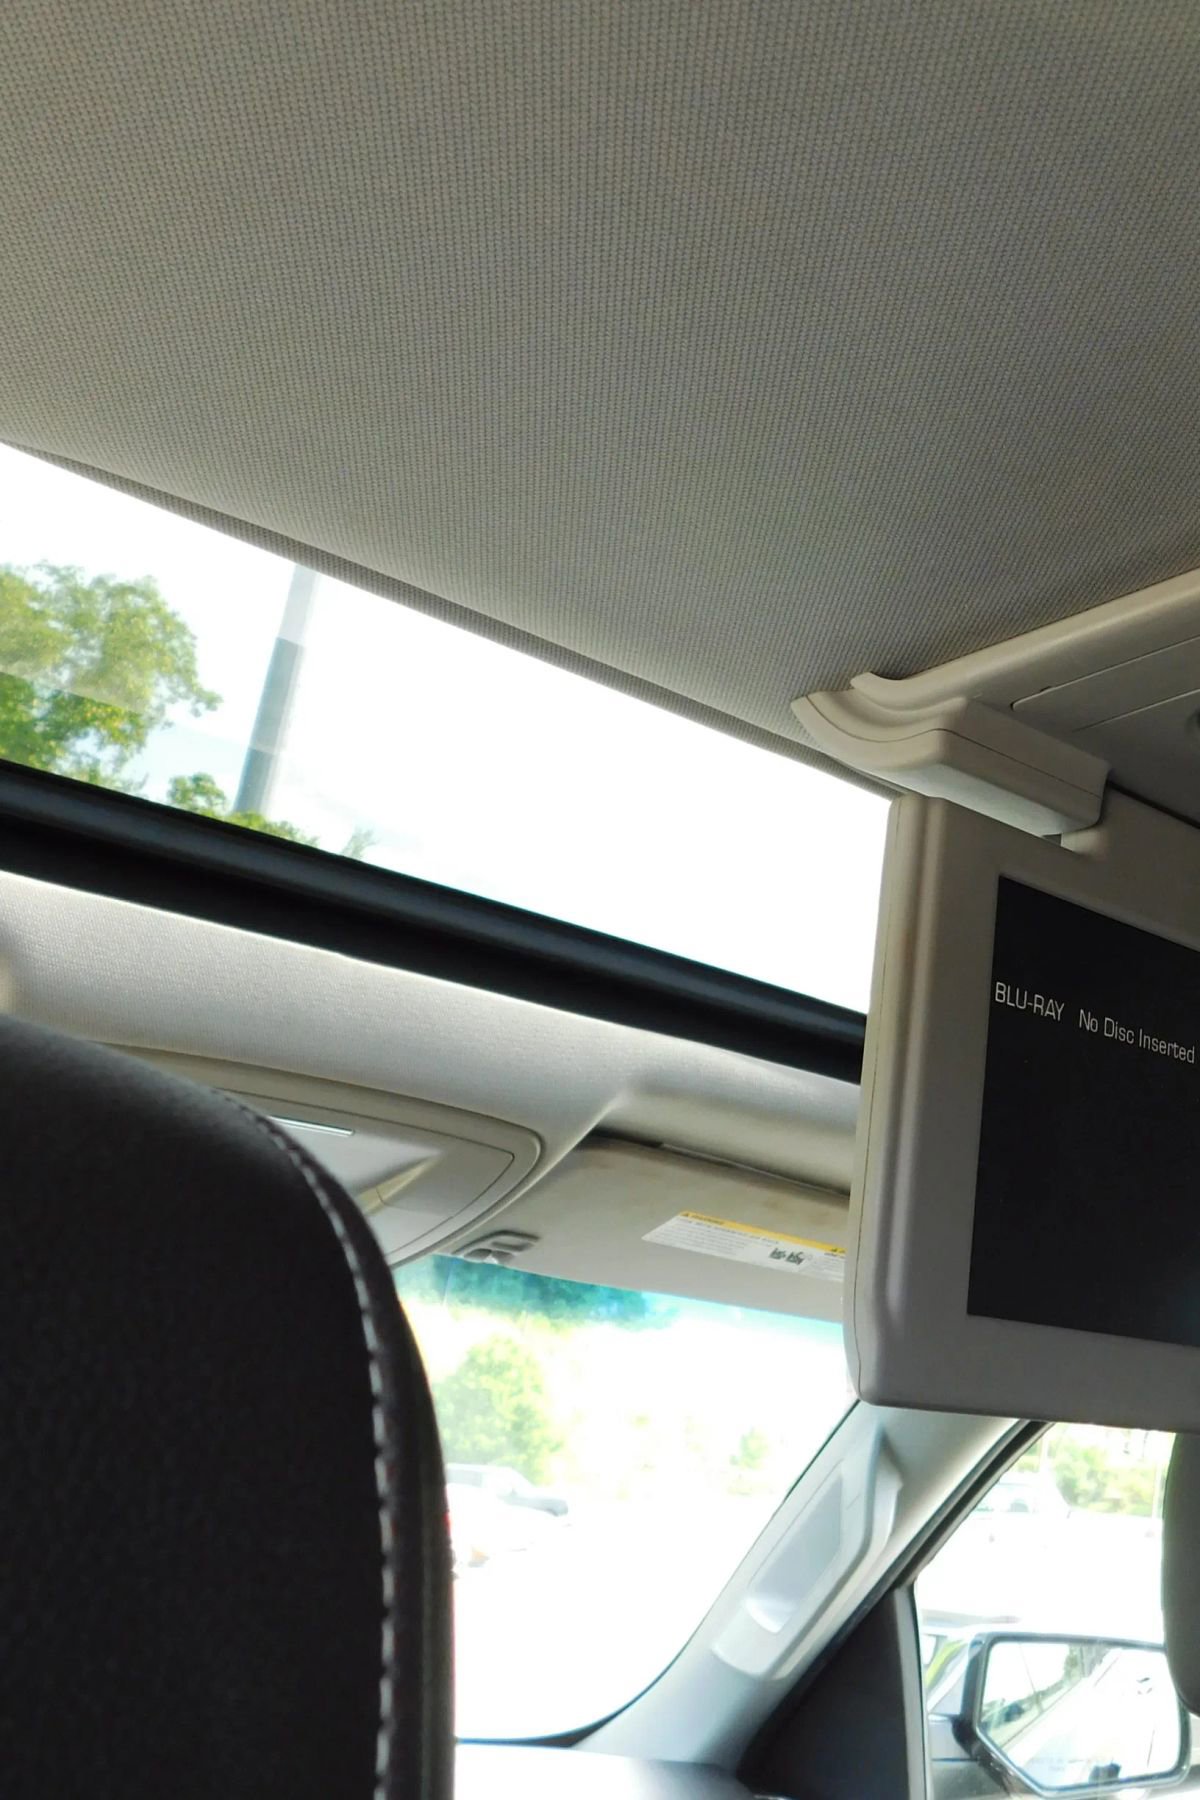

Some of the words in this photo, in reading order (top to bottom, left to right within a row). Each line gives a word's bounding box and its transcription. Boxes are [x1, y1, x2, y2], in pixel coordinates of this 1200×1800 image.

[994, 981, 1065, 1022] BLU-RAY
[1079, 1008, 1099, 1033] No
[1103, 1016, 1135, 1045] Disc
[1138, 1028, 1196, 1064] Inserted
